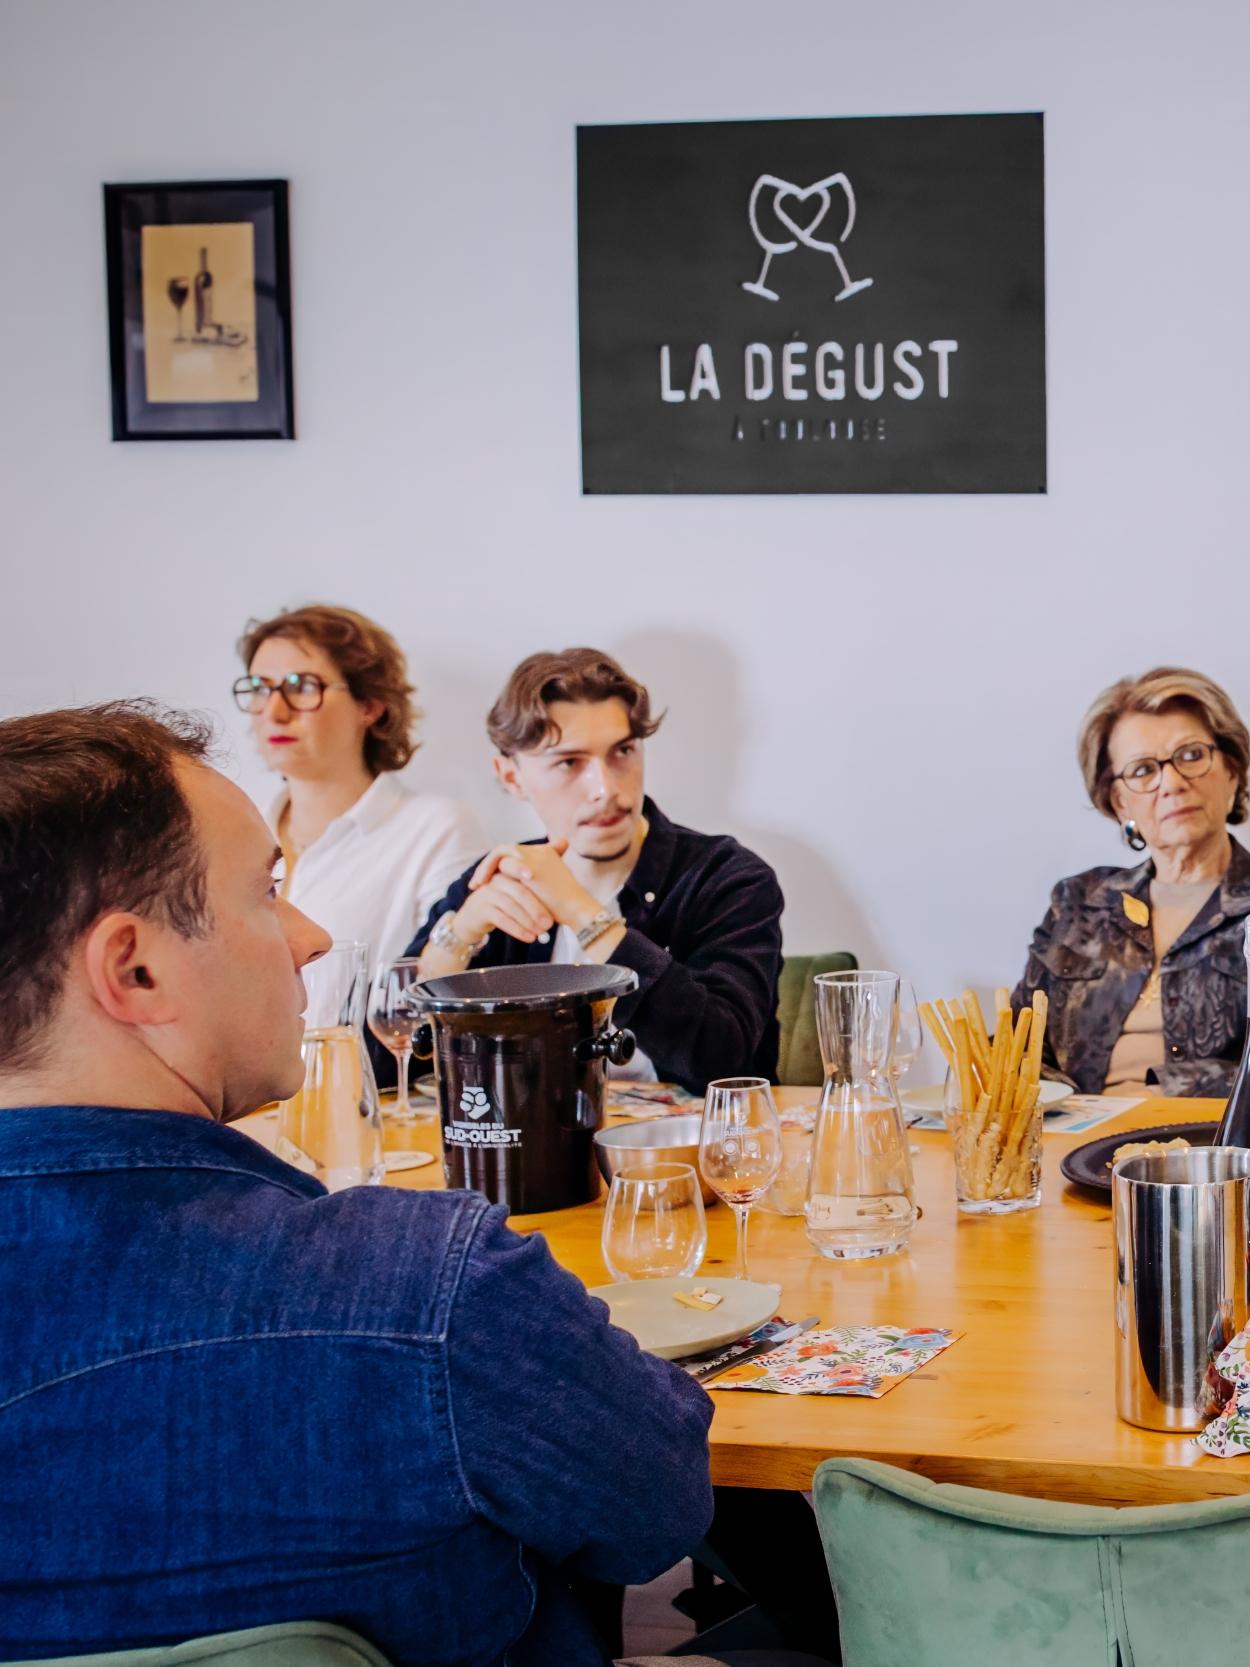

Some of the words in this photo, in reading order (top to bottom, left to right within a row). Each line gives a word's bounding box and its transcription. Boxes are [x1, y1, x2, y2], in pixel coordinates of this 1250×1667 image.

[660, 342, 721, 403] LA
[744, 330, 959, 402] DÉGUST
[444, 1126, 522, 1143] SUD-OUEST
